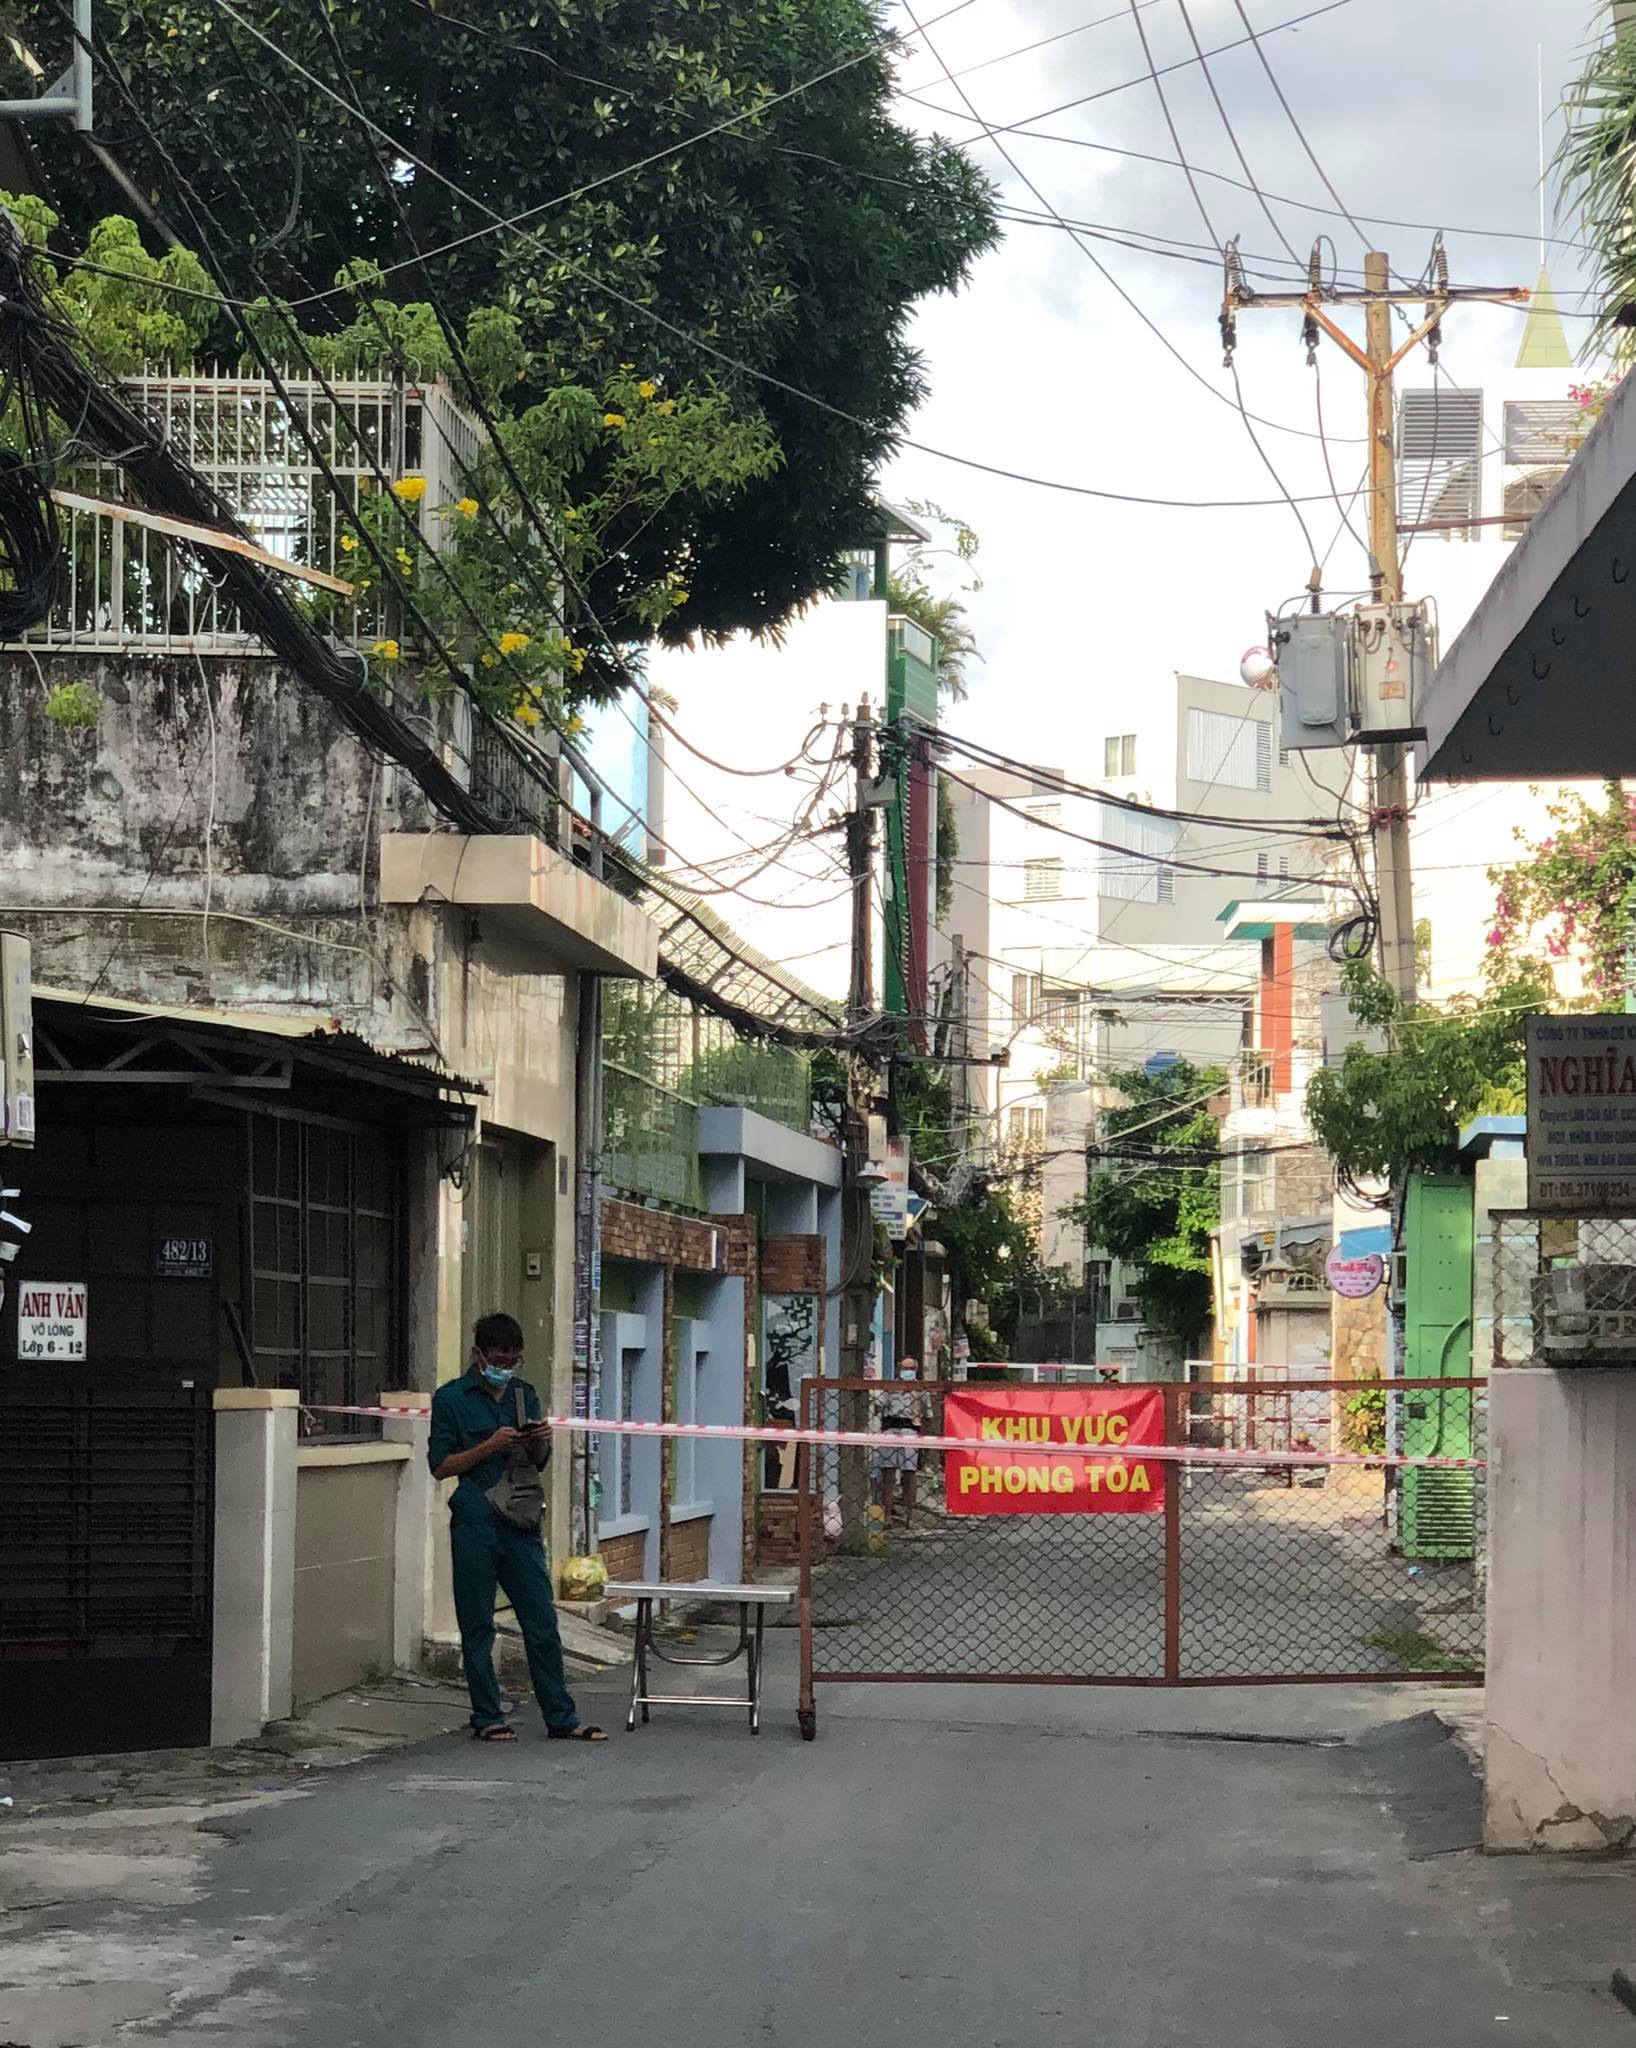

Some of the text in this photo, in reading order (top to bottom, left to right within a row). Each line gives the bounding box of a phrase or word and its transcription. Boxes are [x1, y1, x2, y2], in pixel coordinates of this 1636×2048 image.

[162, 1239, 207, 1261] 482/13
[21, 1287, 85, 1318] ANH VĂN
[22, 1340, 44, 1356] Lớp
[47, 1340, 56, 1354] 6
[68, 1341, 83, 1354] 12
[981, 1416, 1050, 1444] KHU
[959, 1465, 1074, 1494] PHONG
